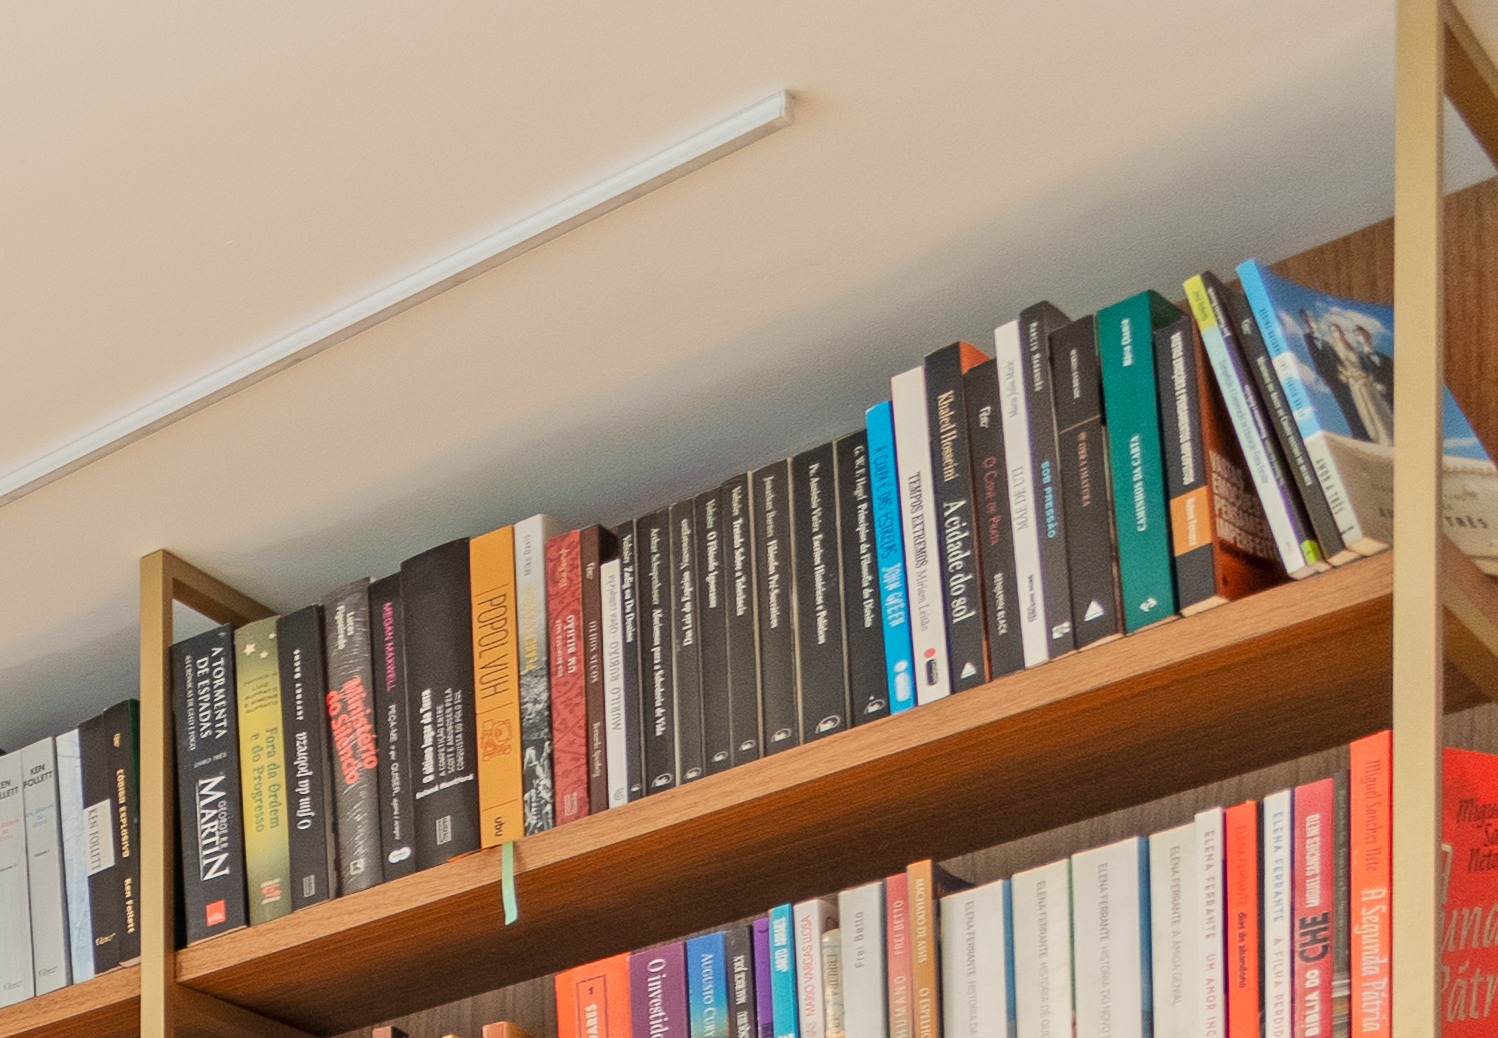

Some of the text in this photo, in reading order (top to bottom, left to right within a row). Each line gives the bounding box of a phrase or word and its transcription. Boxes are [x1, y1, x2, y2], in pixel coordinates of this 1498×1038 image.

[937, 390, 958, 482] Khaled Hosseini
[943, 499, 975, 624] A cidade do sol
[477, 594, 509, 699] POPOL VUH
[196, 657, 212, 739] DE ESPADAS
[265, 726, 282, 829] Fora da Ordem
[293, 732, 313, 777] pobreza
[295, 778, 309, 794] da
[198, 775, 230, 881] MARTIN
[296, 797, 316, 817] fim
[296, 820, 311, 830] O
[647, 958, 666, 973] O
[1298, 912, 1330, 963] CHE
[1352, 888, 1388, 1033] A Segunda Pátria
[701, 953, 717, 1038] AUGUSTO CURY
